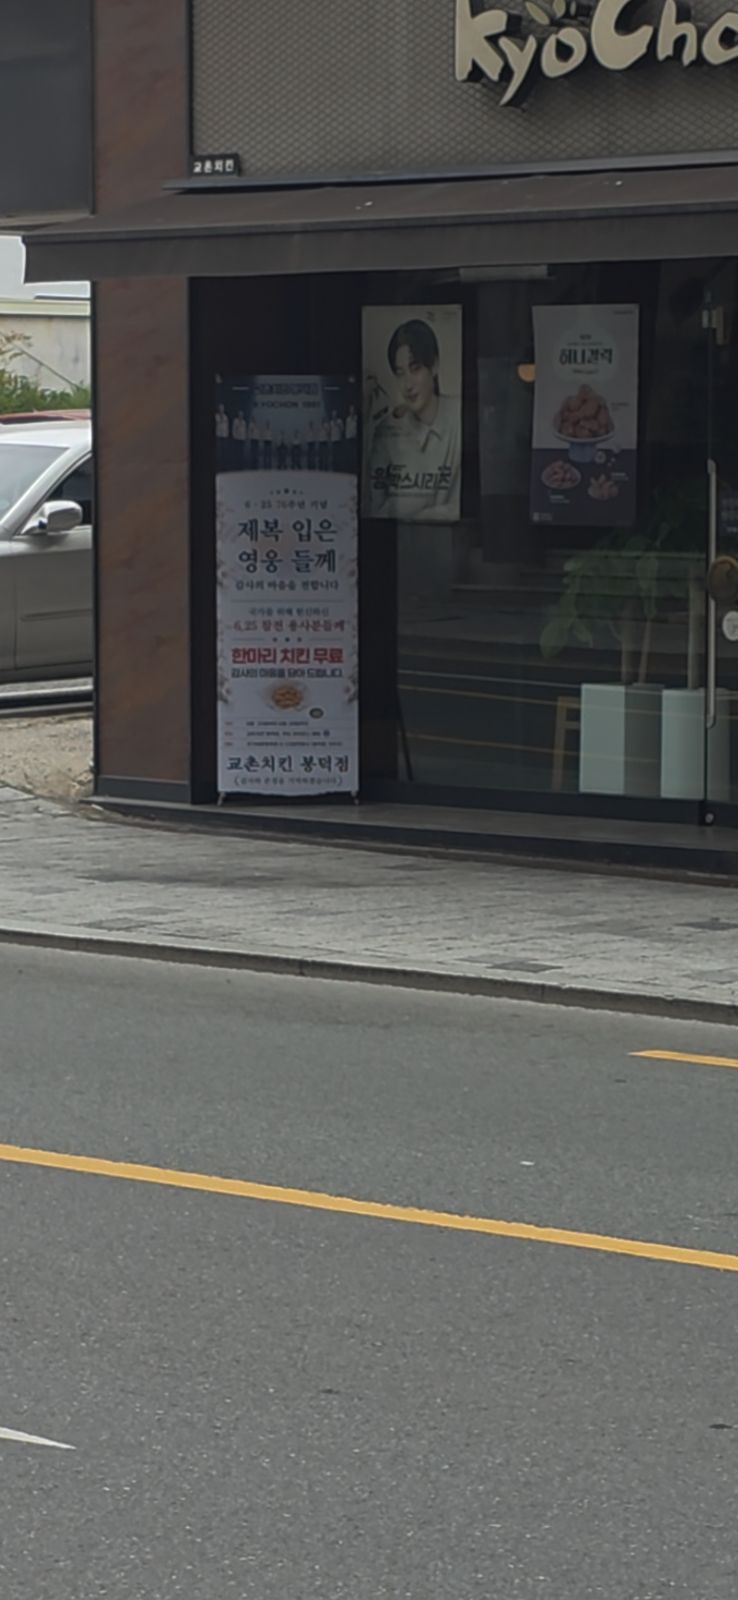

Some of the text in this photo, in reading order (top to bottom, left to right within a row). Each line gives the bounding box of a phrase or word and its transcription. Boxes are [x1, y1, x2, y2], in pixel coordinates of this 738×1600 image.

[193, 159, 234, 173] 교촌치킨
[238, 518, 337, 542] 제복 입은
[238, 549, 336, 573] 영웅 들께
[235, 580, 264, 591] 감사의
[267, 580, 296, 591] 마음을
[231, 647, 344, 664] 한마리 치킨 무료
[231, 668, 258, 678] 감사의
[259, 668, 286, 678] 마음을
[288, 668, 306, 678] 담아
[226, 755, 349, 773] 교촌치킨 봉덕점
